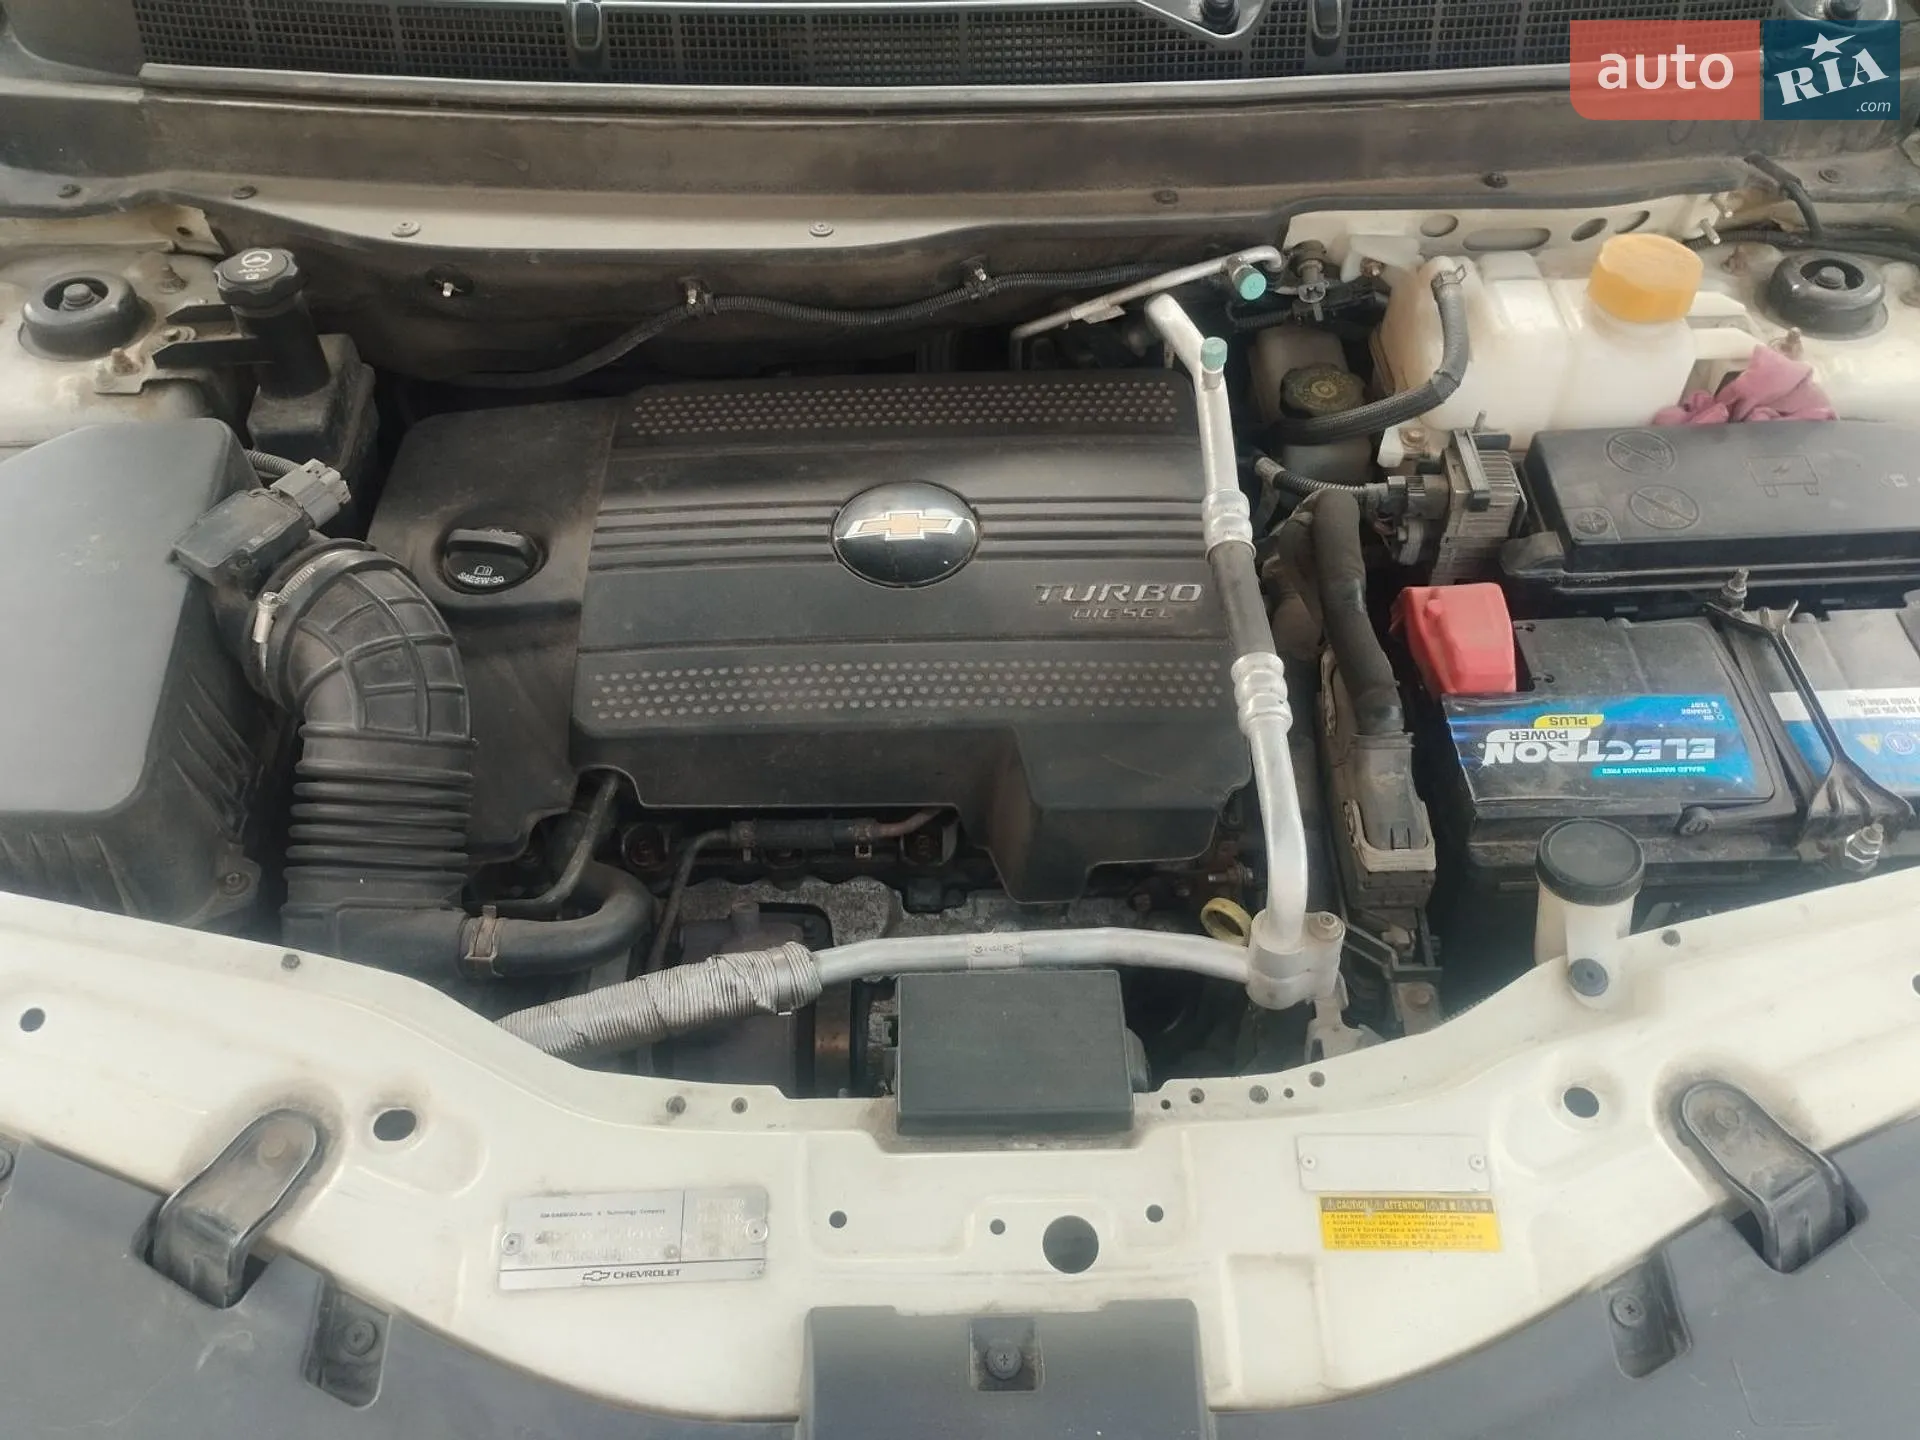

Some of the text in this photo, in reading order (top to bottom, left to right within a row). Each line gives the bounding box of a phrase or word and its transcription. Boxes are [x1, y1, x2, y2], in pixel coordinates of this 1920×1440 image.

[1034, 584, 1203, 602] TURBO
[1072, 608, 1172, 619] DIESEL
[1549, 716, 1588, 726] PLUS
[1509, 730, 1568, 741] POWER
[1483, 738, 1715, 765] ELECTRON
[1383, 1199, 1425, 1210] ATTENTION
[613, 1269, 682, 1279] CHEVROLET
